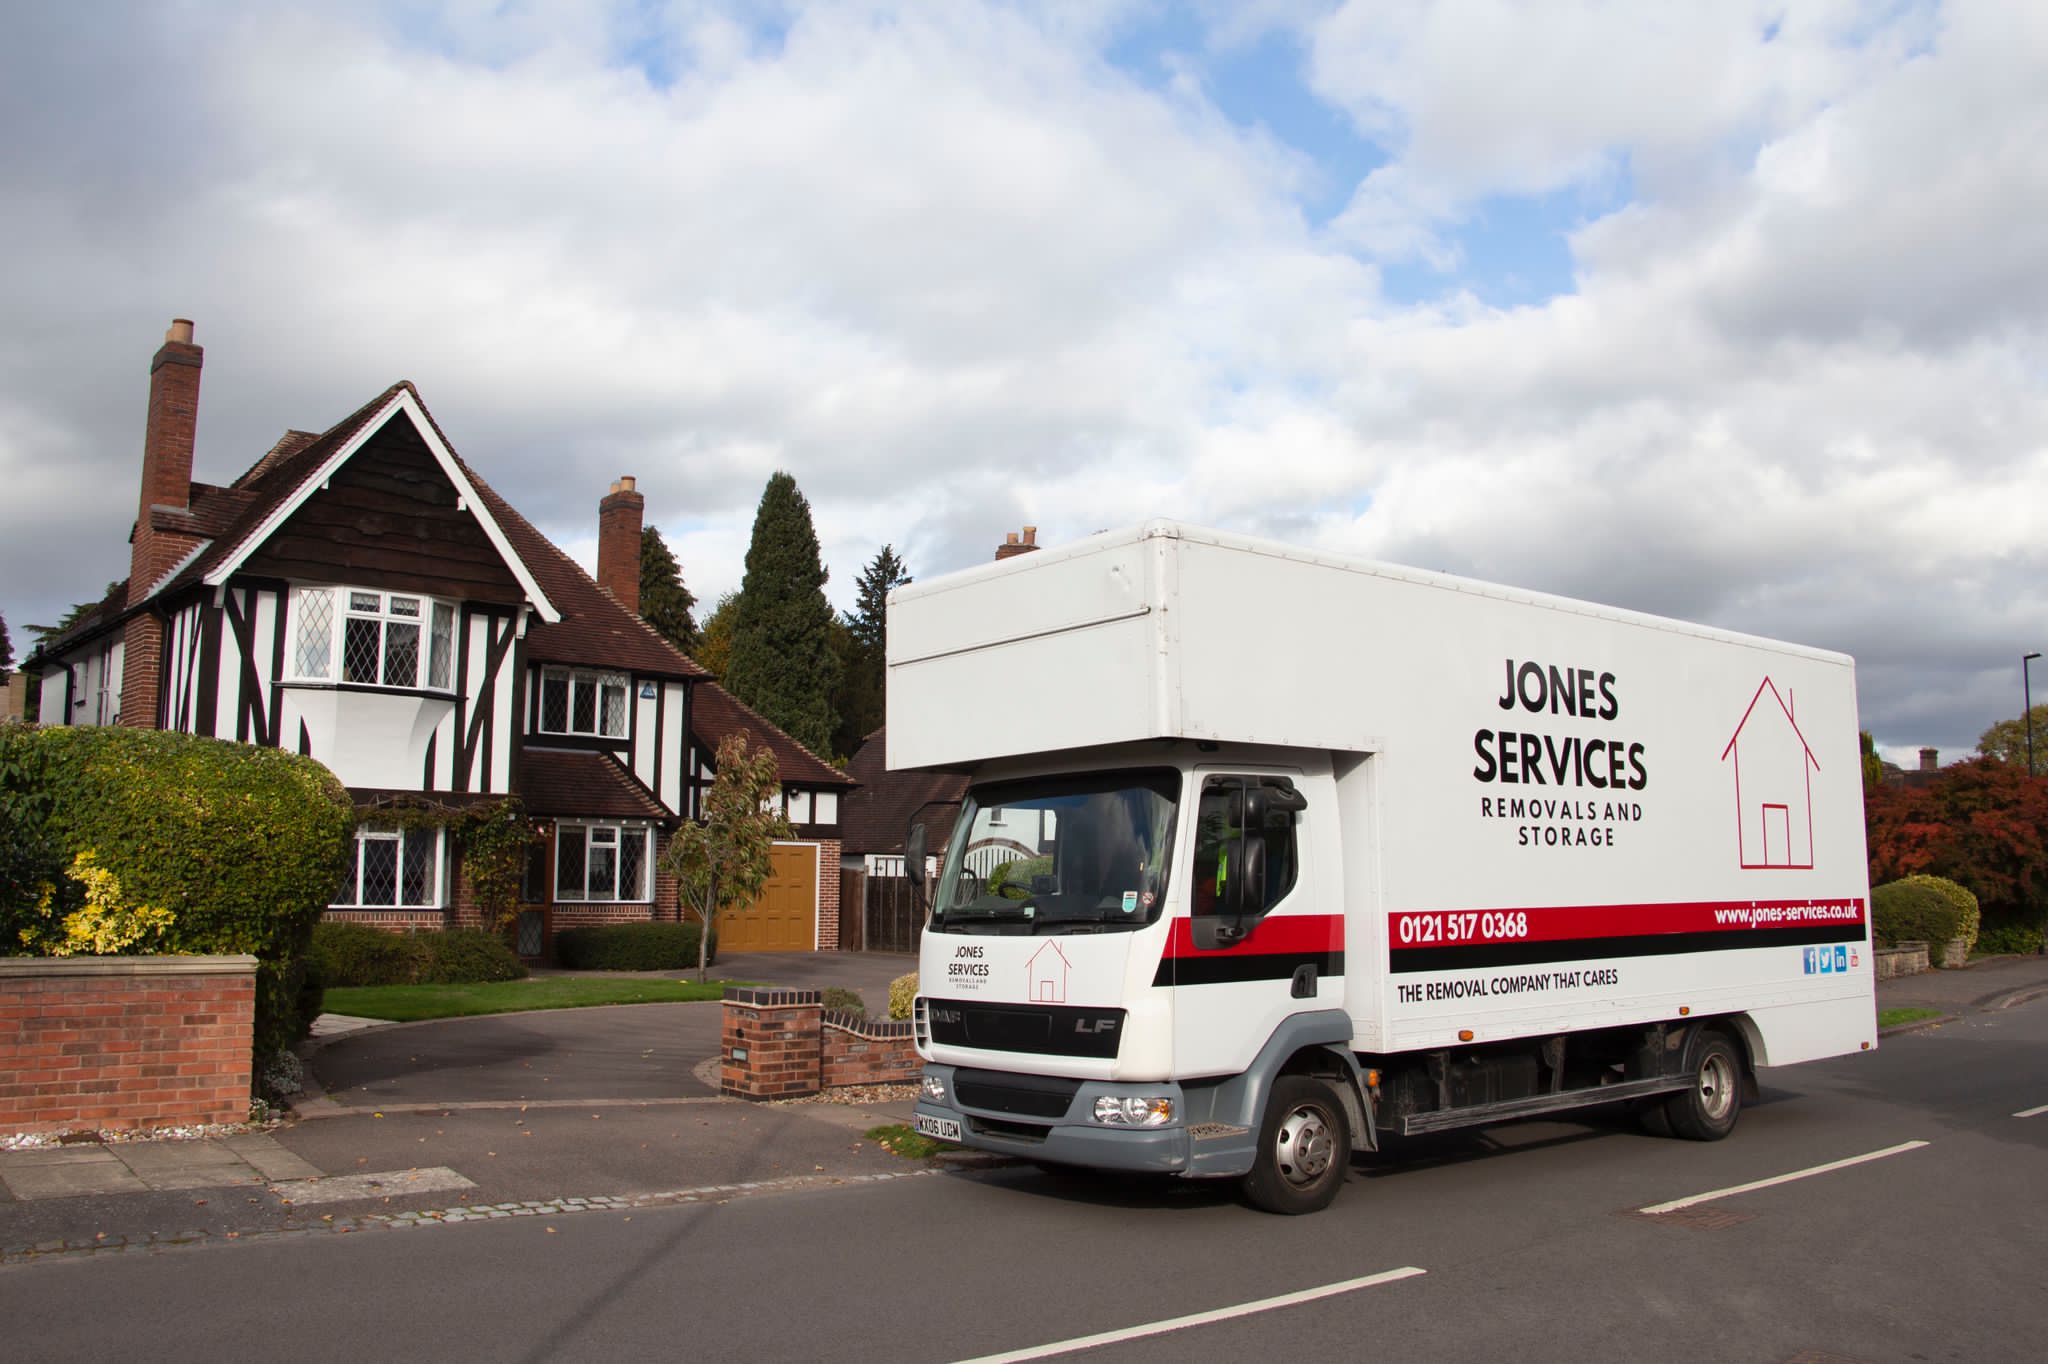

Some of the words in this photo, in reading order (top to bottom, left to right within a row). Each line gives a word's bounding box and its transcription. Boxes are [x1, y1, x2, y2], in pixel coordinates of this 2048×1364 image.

[1498, 658, 1619, 721] JONES
[1473, 728, 1648, 791] SERVICES
[1481, 797, 1597, 820] REMOVALS
[1604, 802, 1643, 821] AND
[1518, 825, 1614, 847] STORAGE
[1399, 914, 1443, 944] 0121
[1447, 913, 1479, 941] 517
[1481, 911, 1528, 939] 0368
[1714, 899, 1858, 929] www.jones-services.co.uk
[955, 946, 984, 959] JONES
[948, 963, 989, 977] SERVICES
[1398, 983, 1423, 1004] THE
[1426, 979, 1488, 1001] REMOVAL
[1491, 973, 1551, 996] COMPANY
[1553, 970, 1581, 990] THAT
[1583, 968, 1618, 986] CARES
[1074, 1018, 1116, 1034] LF
